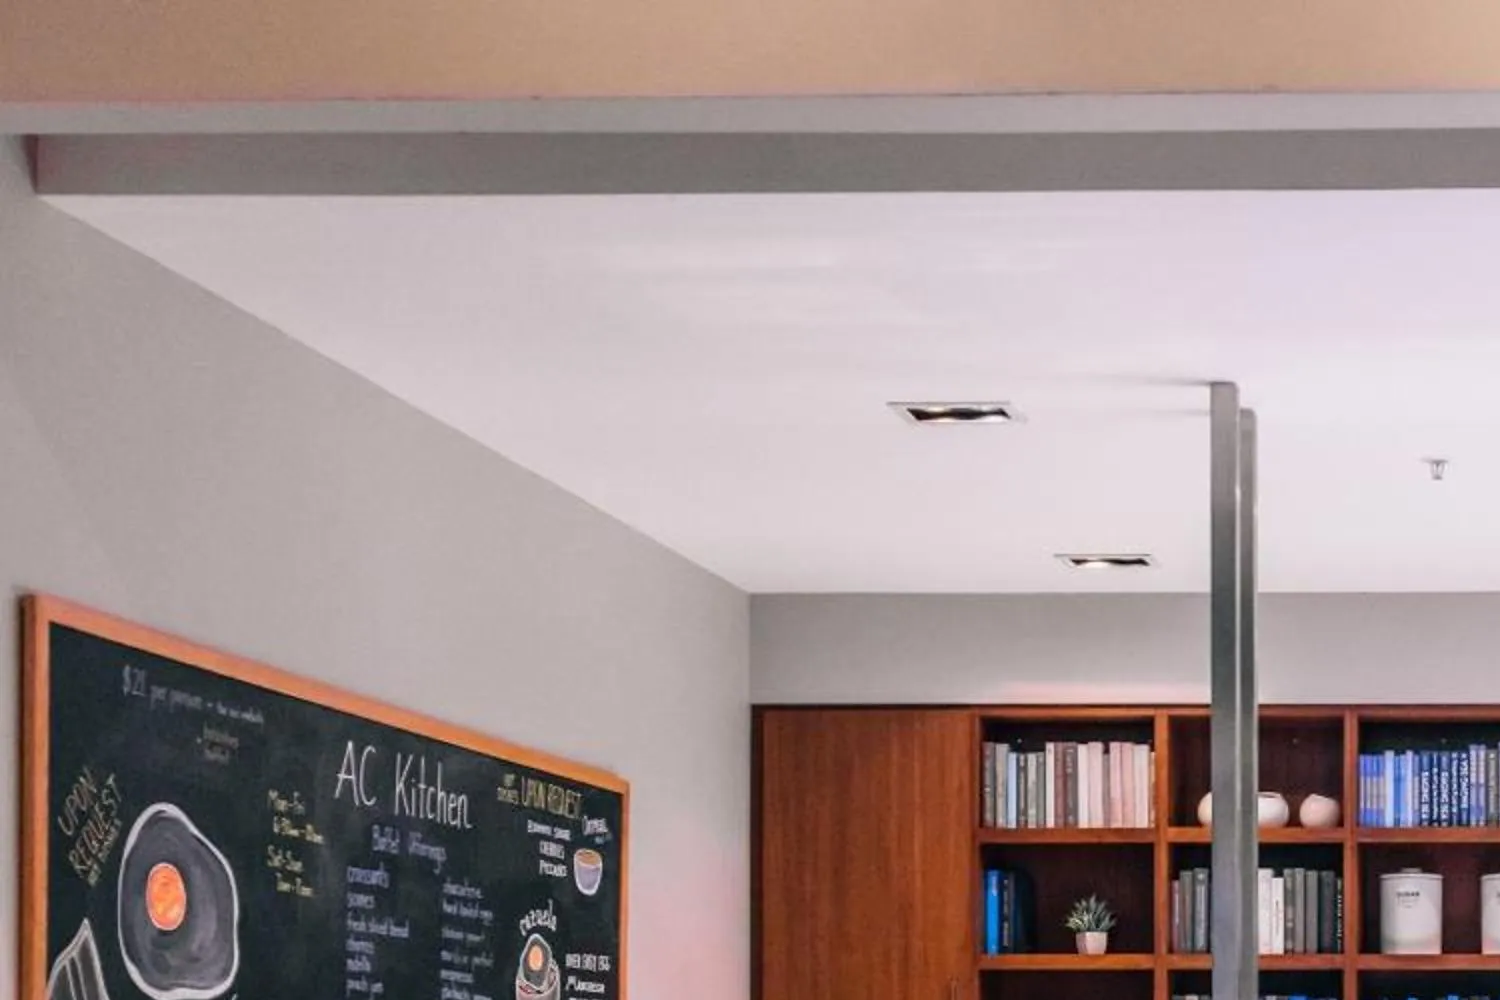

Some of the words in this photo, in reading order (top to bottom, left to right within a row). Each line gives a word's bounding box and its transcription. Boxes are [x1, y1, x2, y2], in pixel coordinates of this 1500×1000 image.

[57, 765, 97, 837] UPON
[68, 773, 122, 879] REQUEST
[333, 740, 377, 807] AC
[394, 752, 473, 830] Kitchen
